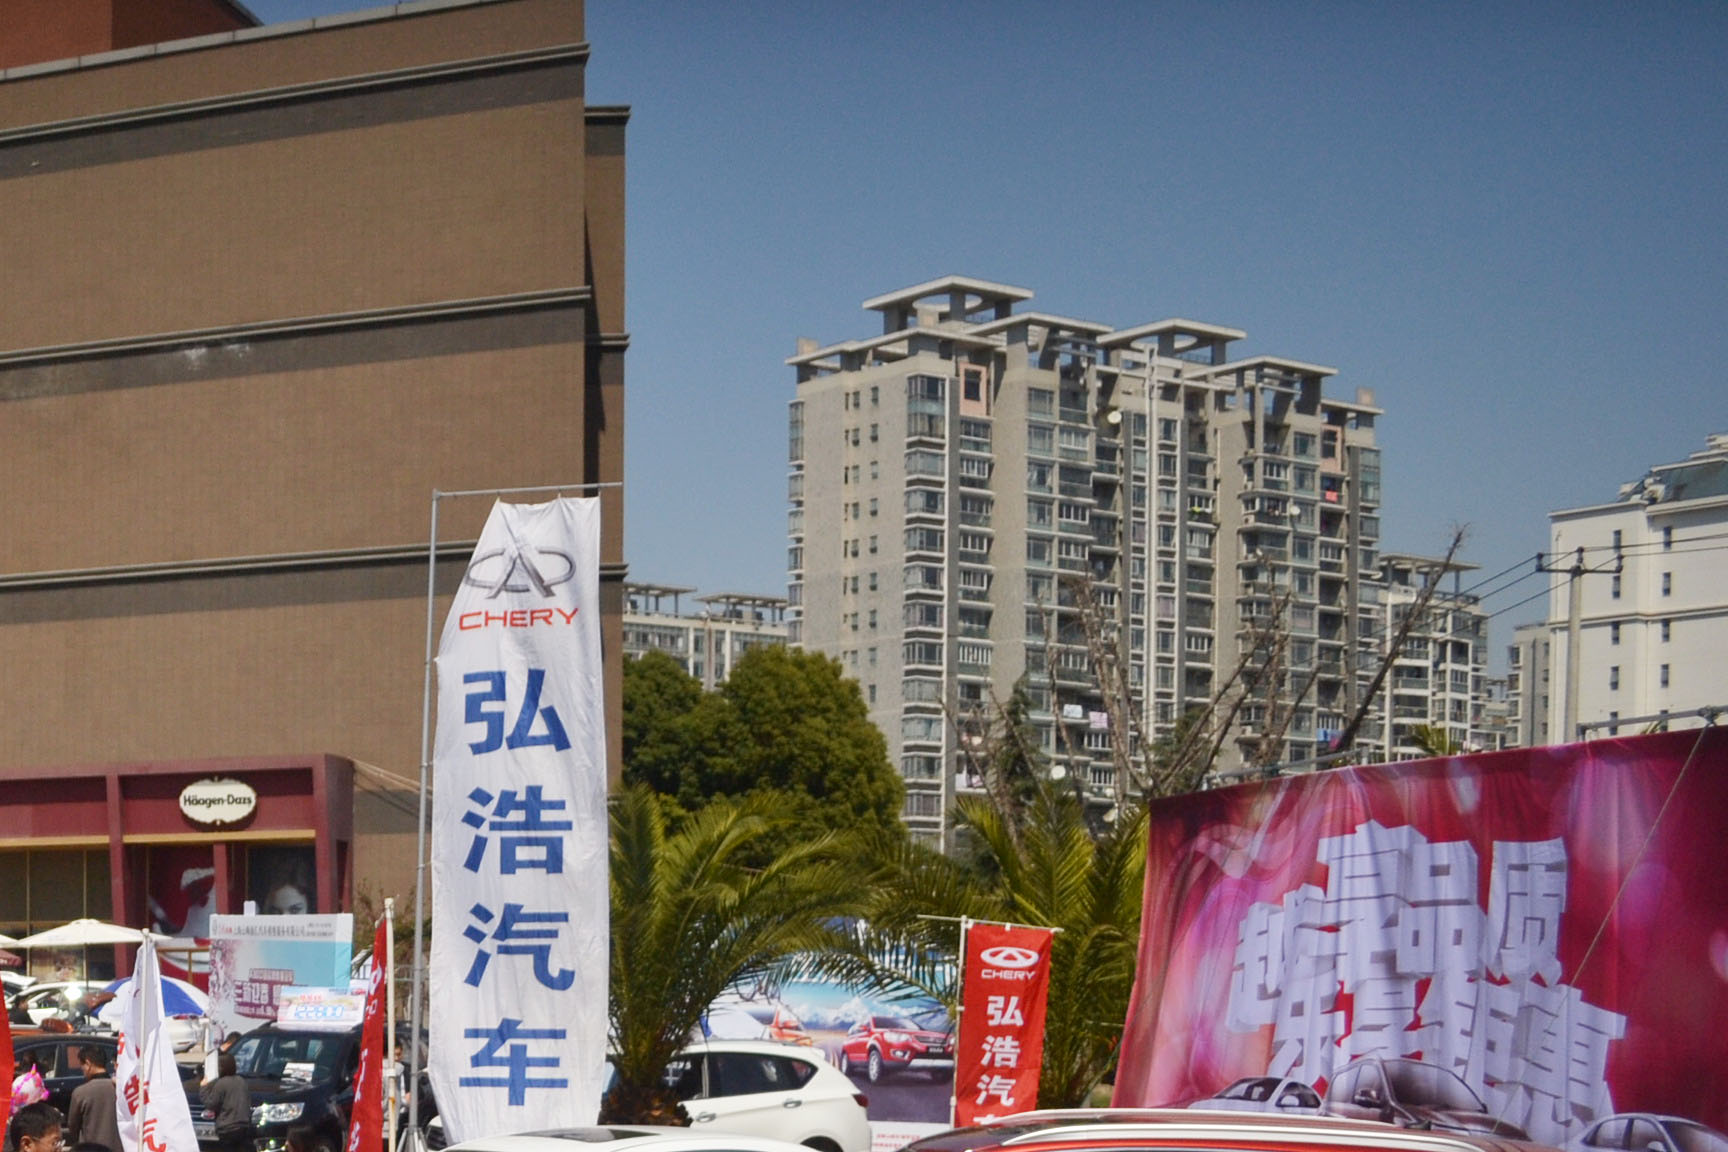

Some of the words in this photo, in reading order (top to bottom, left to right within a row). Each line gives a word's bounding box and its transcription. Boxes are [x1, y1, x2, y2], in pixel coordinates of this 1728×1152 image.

[458, 607, 580, 631] CHERY
[183, 794, 252, 809] Häagen-Dazs
[459, 669, 575, 1106] 弘浩汽车
[981, 969, 1036, 980] CHERY
[974, 996, 1024, 1125] 弘浩汽
